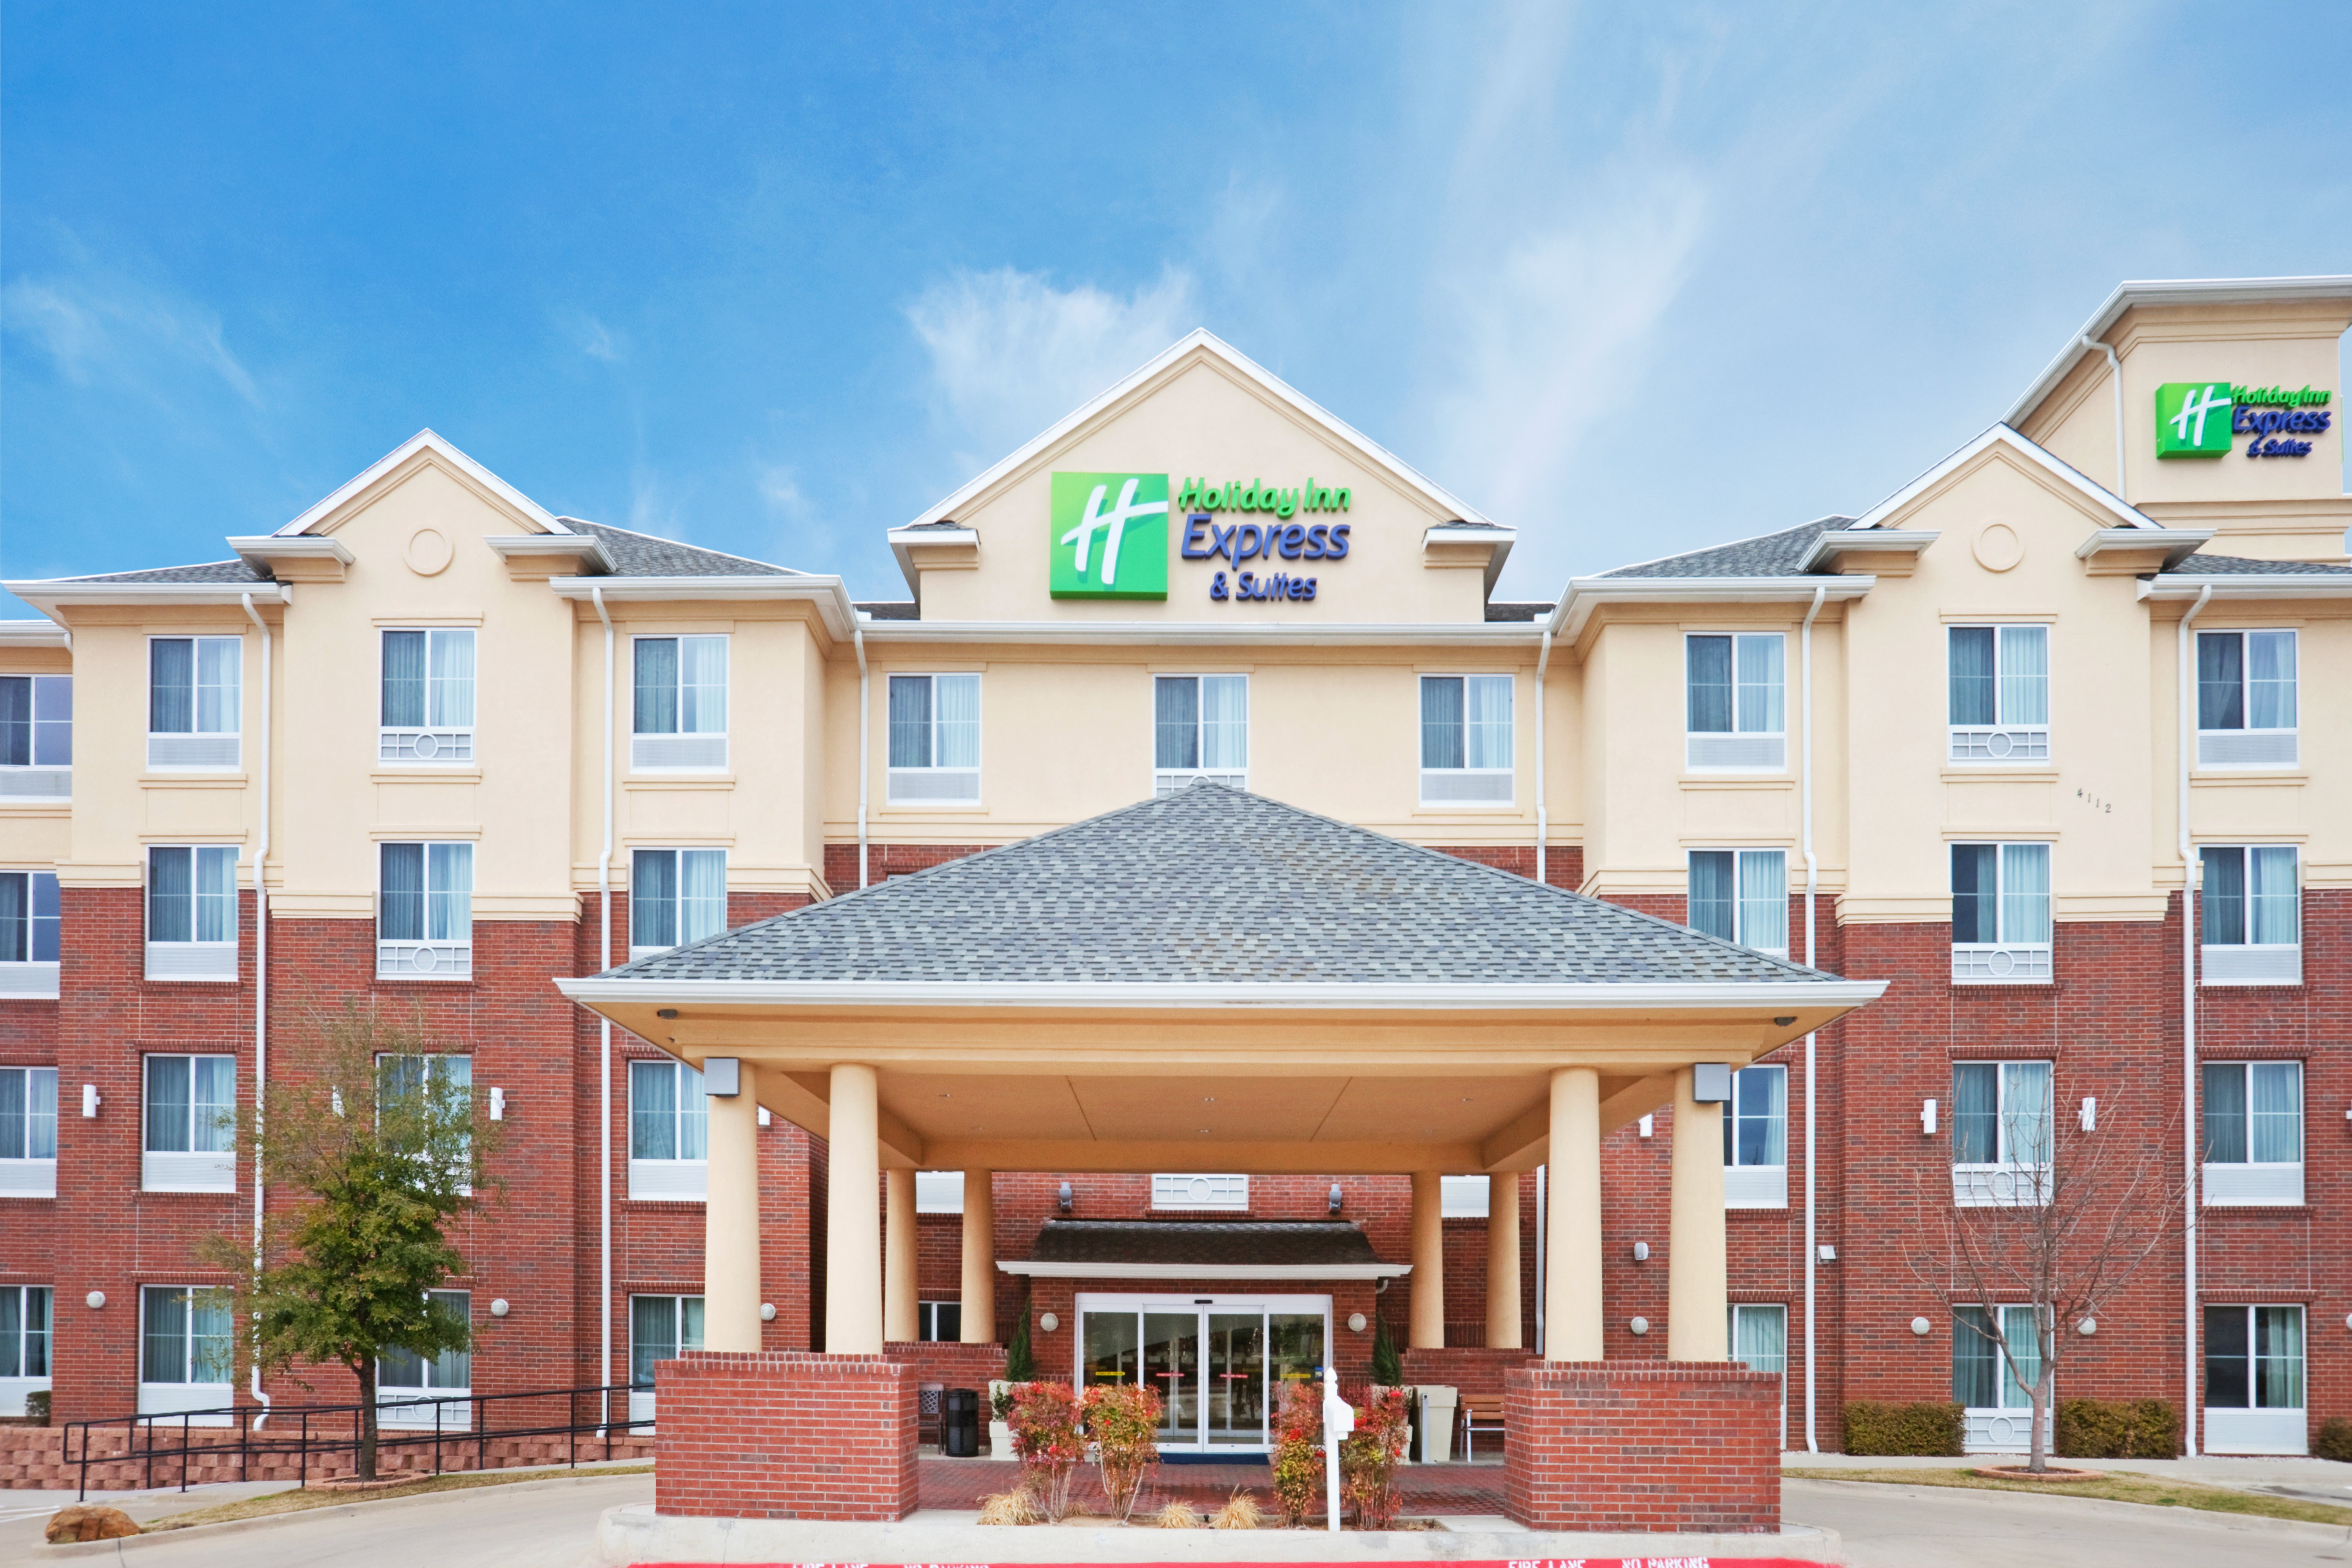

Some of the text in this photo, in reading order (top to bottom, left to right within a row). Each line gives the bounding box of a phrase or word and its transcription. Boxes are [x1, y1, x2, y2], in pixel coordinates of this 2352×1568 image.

[2231, 385, 2332, 409] Holiday Inn
[2232, 405, 2331, 438] Express
[2247, 438, 2312, 457] & Suites
[1178, 477, 1351, 519] Holiday Inn
[1181, 514, 1351, 572] Express
[1210, 572, 1318, 601] & Suites
[2077, 788, 2111, 813] 4112
